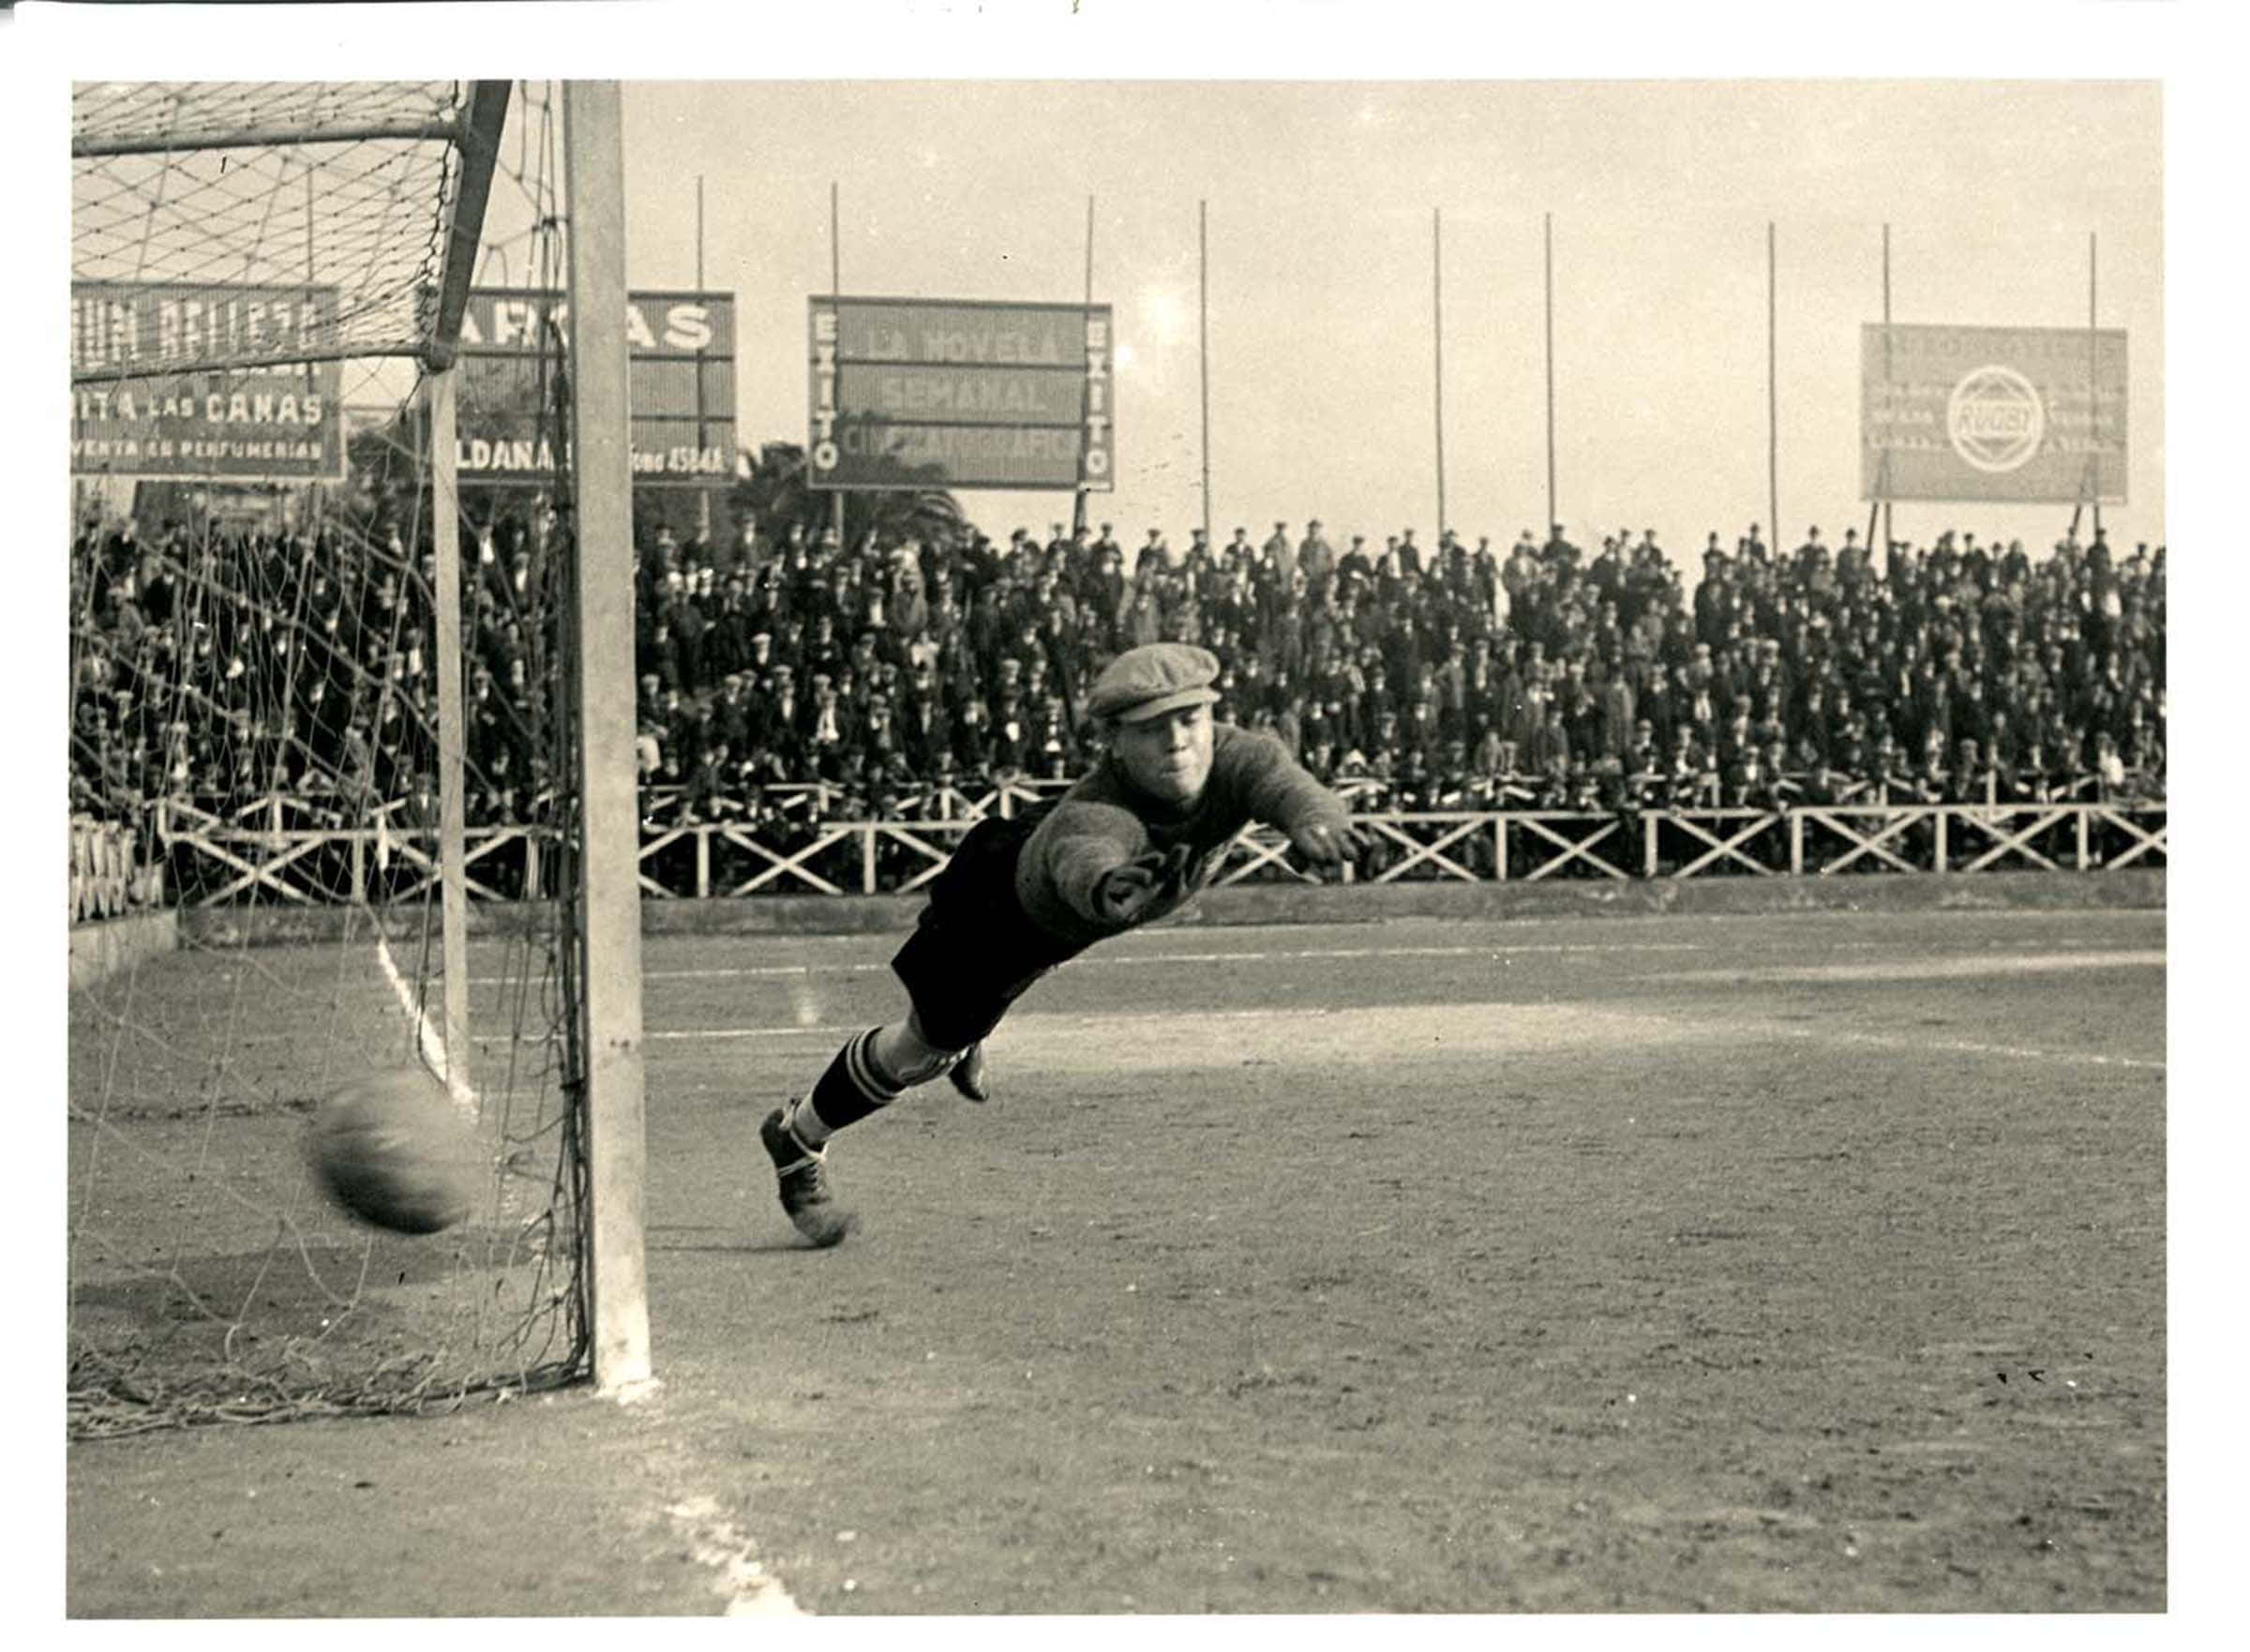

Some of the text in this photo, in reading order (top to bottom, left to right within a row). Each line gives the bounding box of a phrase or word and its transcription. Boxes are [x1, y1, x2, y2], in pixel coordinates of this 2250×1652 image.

[867, 328, 1059, 363] LA NOVELA
[205, 392, 322, 425] CANAS
[815, 311, 837, 471] EXITO
[882, 375, 1048, 413] SEMANAL
[455, 439, 555, 470] LDANA
